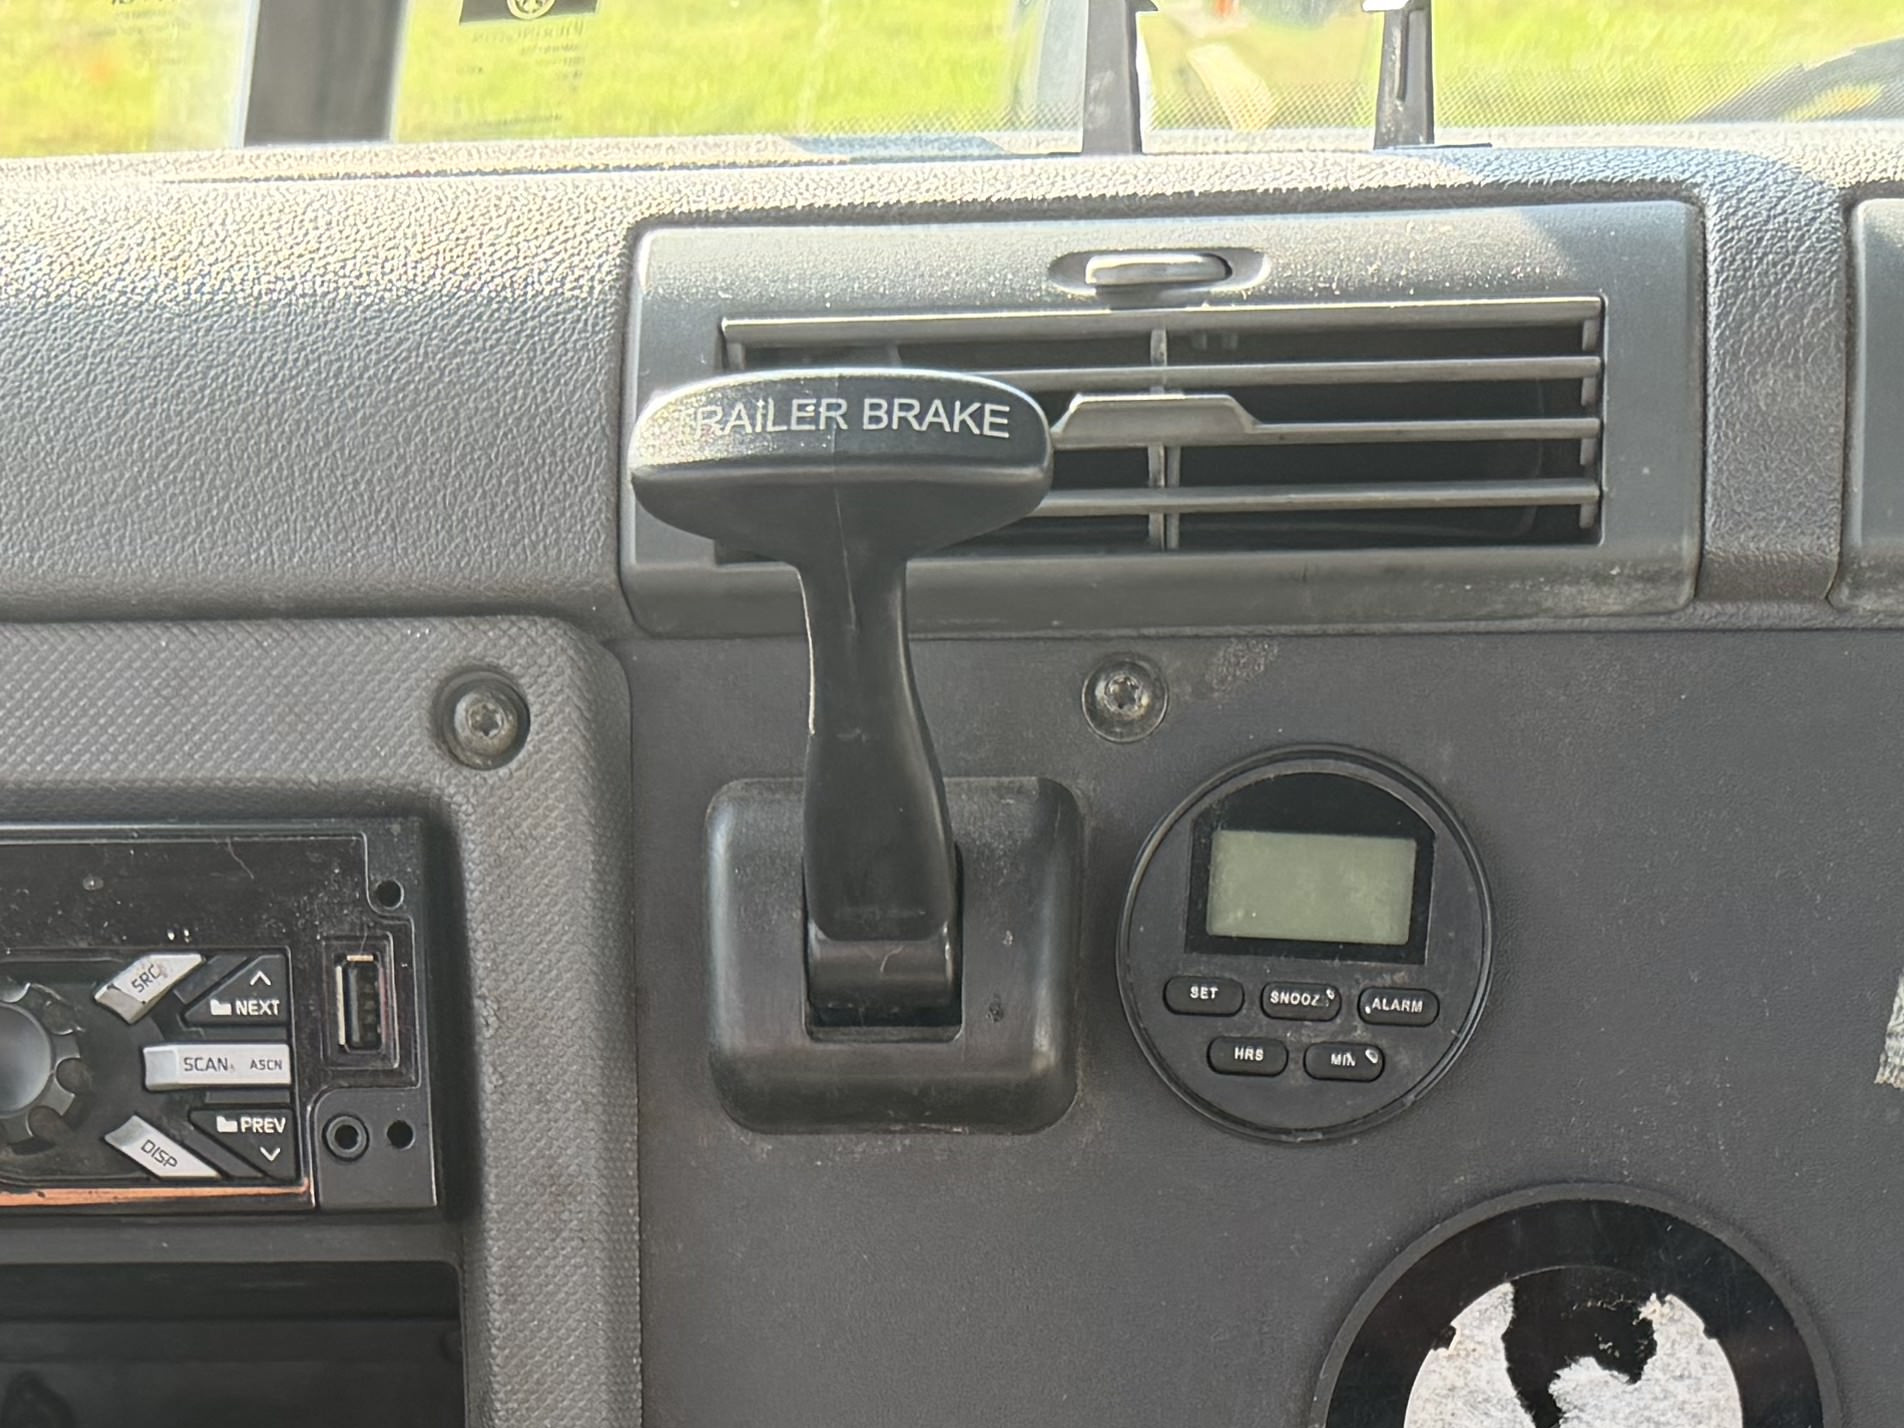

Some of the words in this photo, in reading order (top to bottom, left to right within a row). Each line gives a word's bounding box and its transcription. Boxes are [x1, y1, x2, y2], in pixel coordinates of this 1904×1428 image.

[679, 398, 848, 438] RAILER
[863, 398, 1010, 439] BRAKE
[131, 964, 162, 993] SRC
[1190, 986, 1218, 999] SET
[1270, 991, 1330, 1007] SNOOZ
[236, 1000, 280, 1016] NEXT
[1372, 998, 1424, 1013] ALARM
[1234, 1048, 1264, 1061] HRS
[183, 1057, 228, 1072] SCAN
[250, 1060, 283, 1070] ASCN
[241, 1116, 286, 1134] PREV
[141, 1139, 178, 1168] DISP
